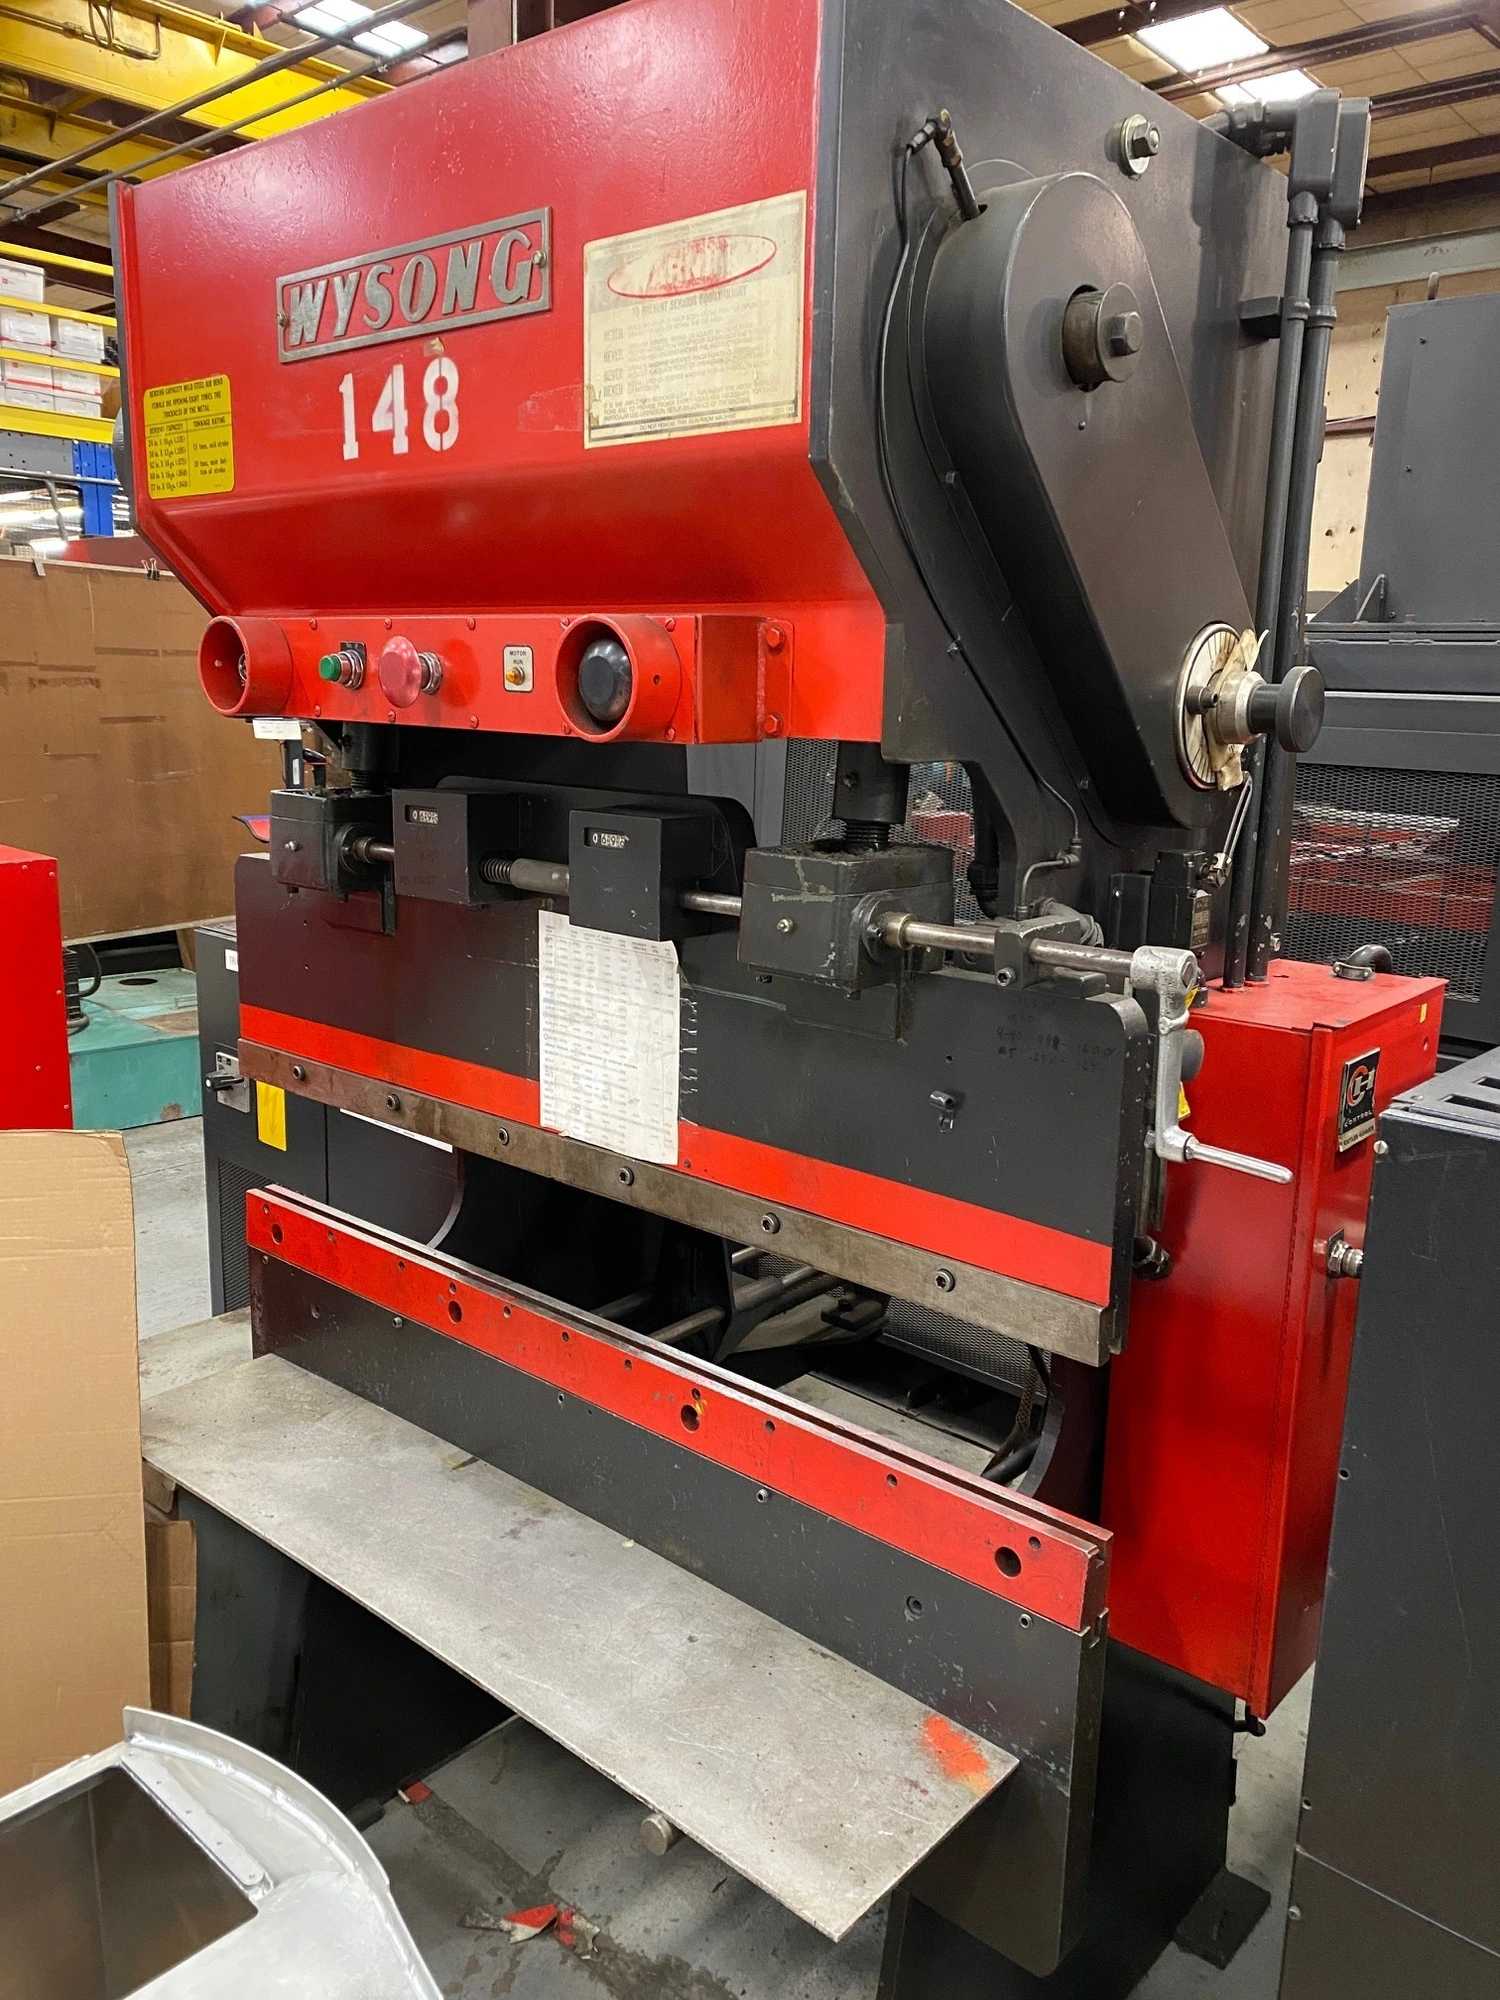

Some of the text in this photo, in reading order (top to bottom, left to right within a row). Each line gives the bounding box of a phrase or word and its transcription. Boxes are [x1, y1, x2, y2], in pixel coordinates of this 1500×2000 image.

[289, 229, 533, 346] WYSONG
[339, 357, 460, 460] 148
[1344, 1111, 1373, 1128] CONTROL
